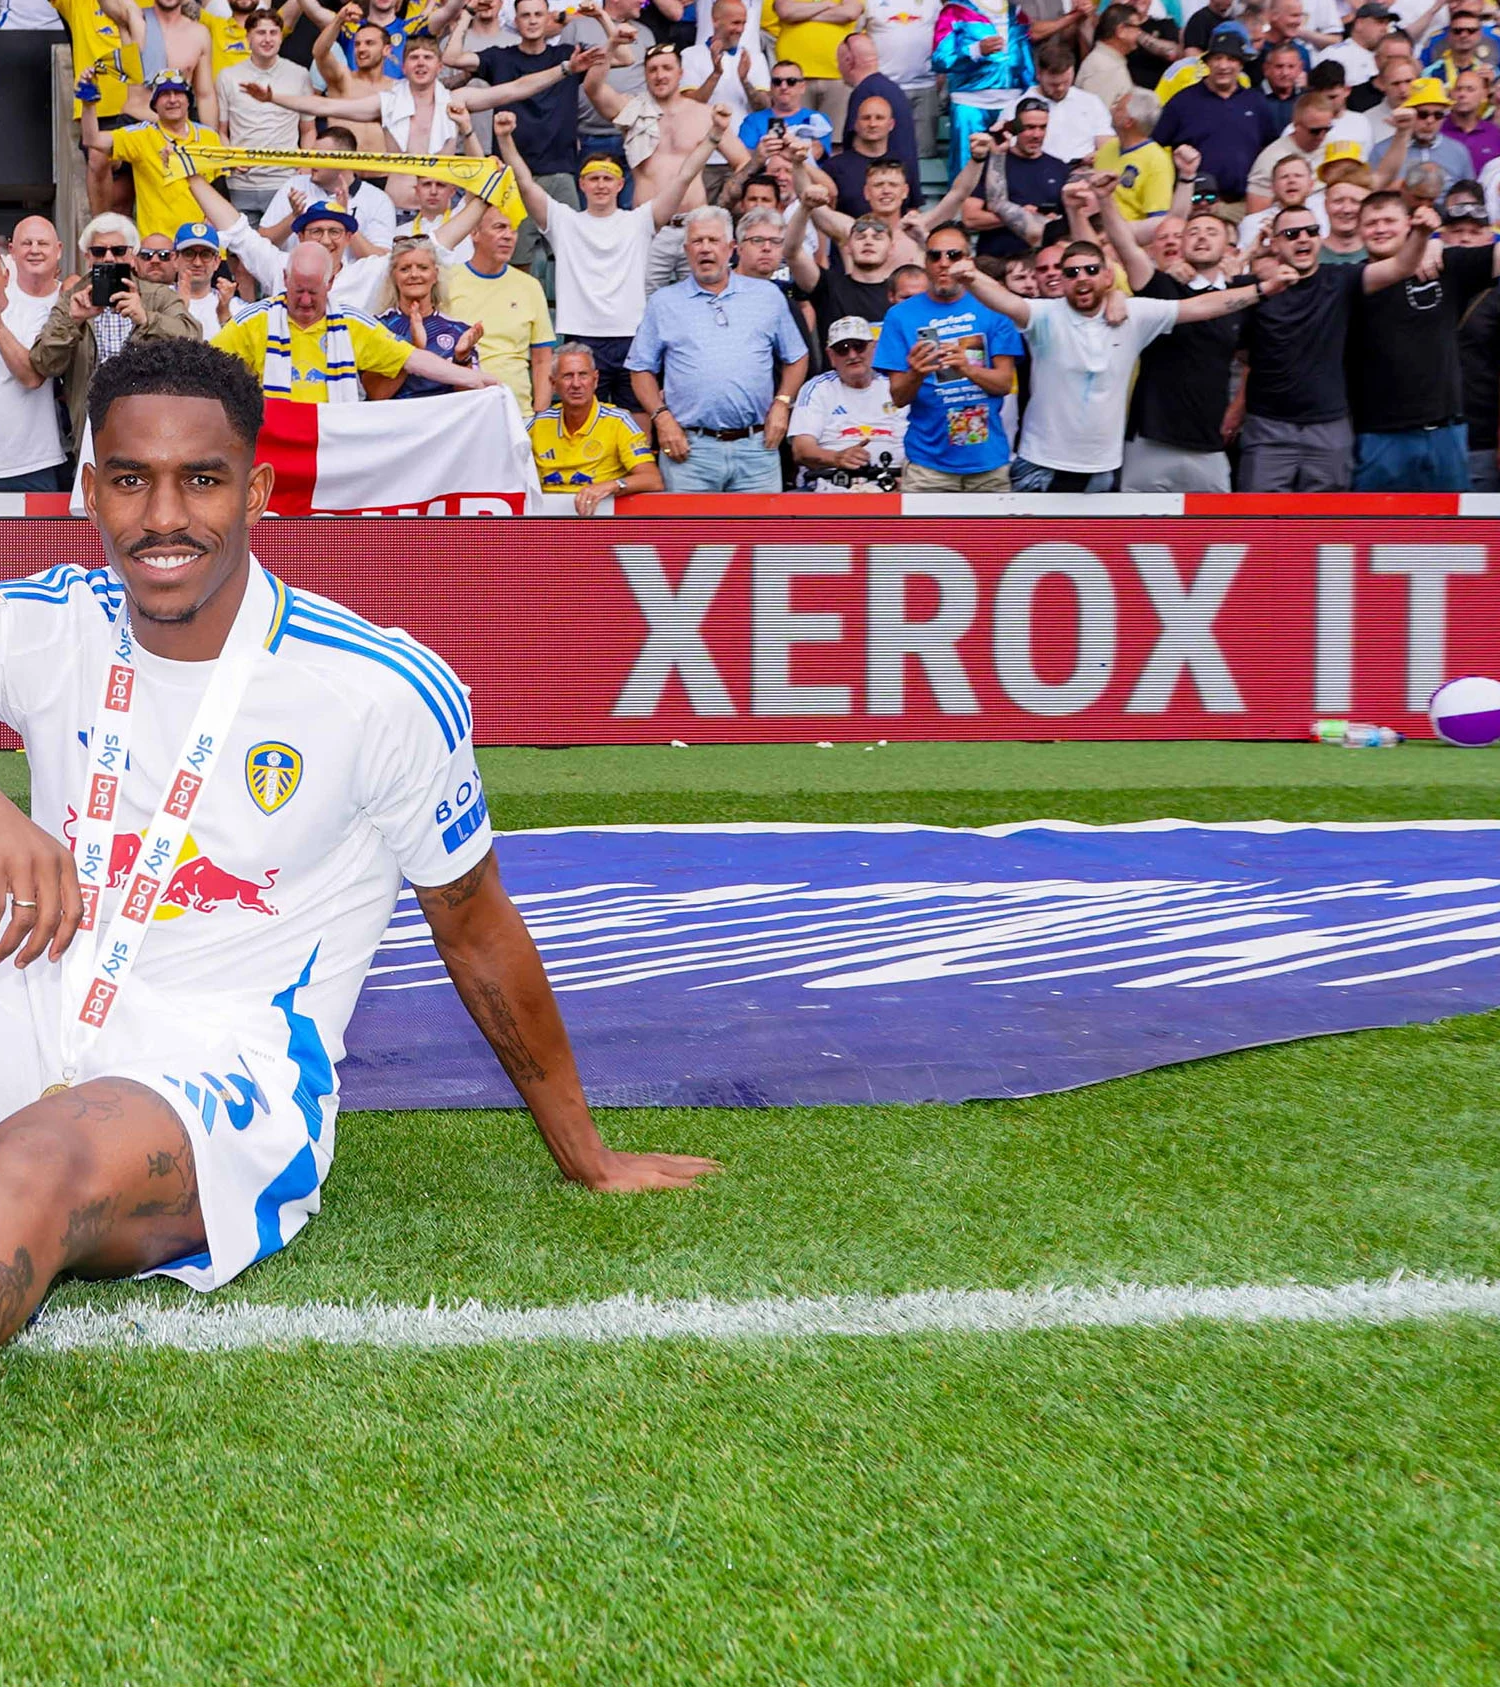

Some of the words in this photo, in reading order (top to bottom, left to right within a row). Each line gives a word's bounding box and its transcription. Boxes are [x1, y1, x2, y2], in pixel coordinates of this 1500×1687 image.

[611, 541, 1249, 717] XEROX
[1312, 543, 1488, 713] IT
[110, 670, 132, 707] bet
[97, 734, 122, 771] sky
[186, 734, 213, 772] sky
[93, 778, 116, 816] bet
[169, 775, 200, 815] bet
[80, 843, 103, 881] sky
[144, 837, 171, 875] sky
[128, 879, 158, 920] bet
[102, 941, 128, 979] sky
[84, 983, 115, 1024] bet
